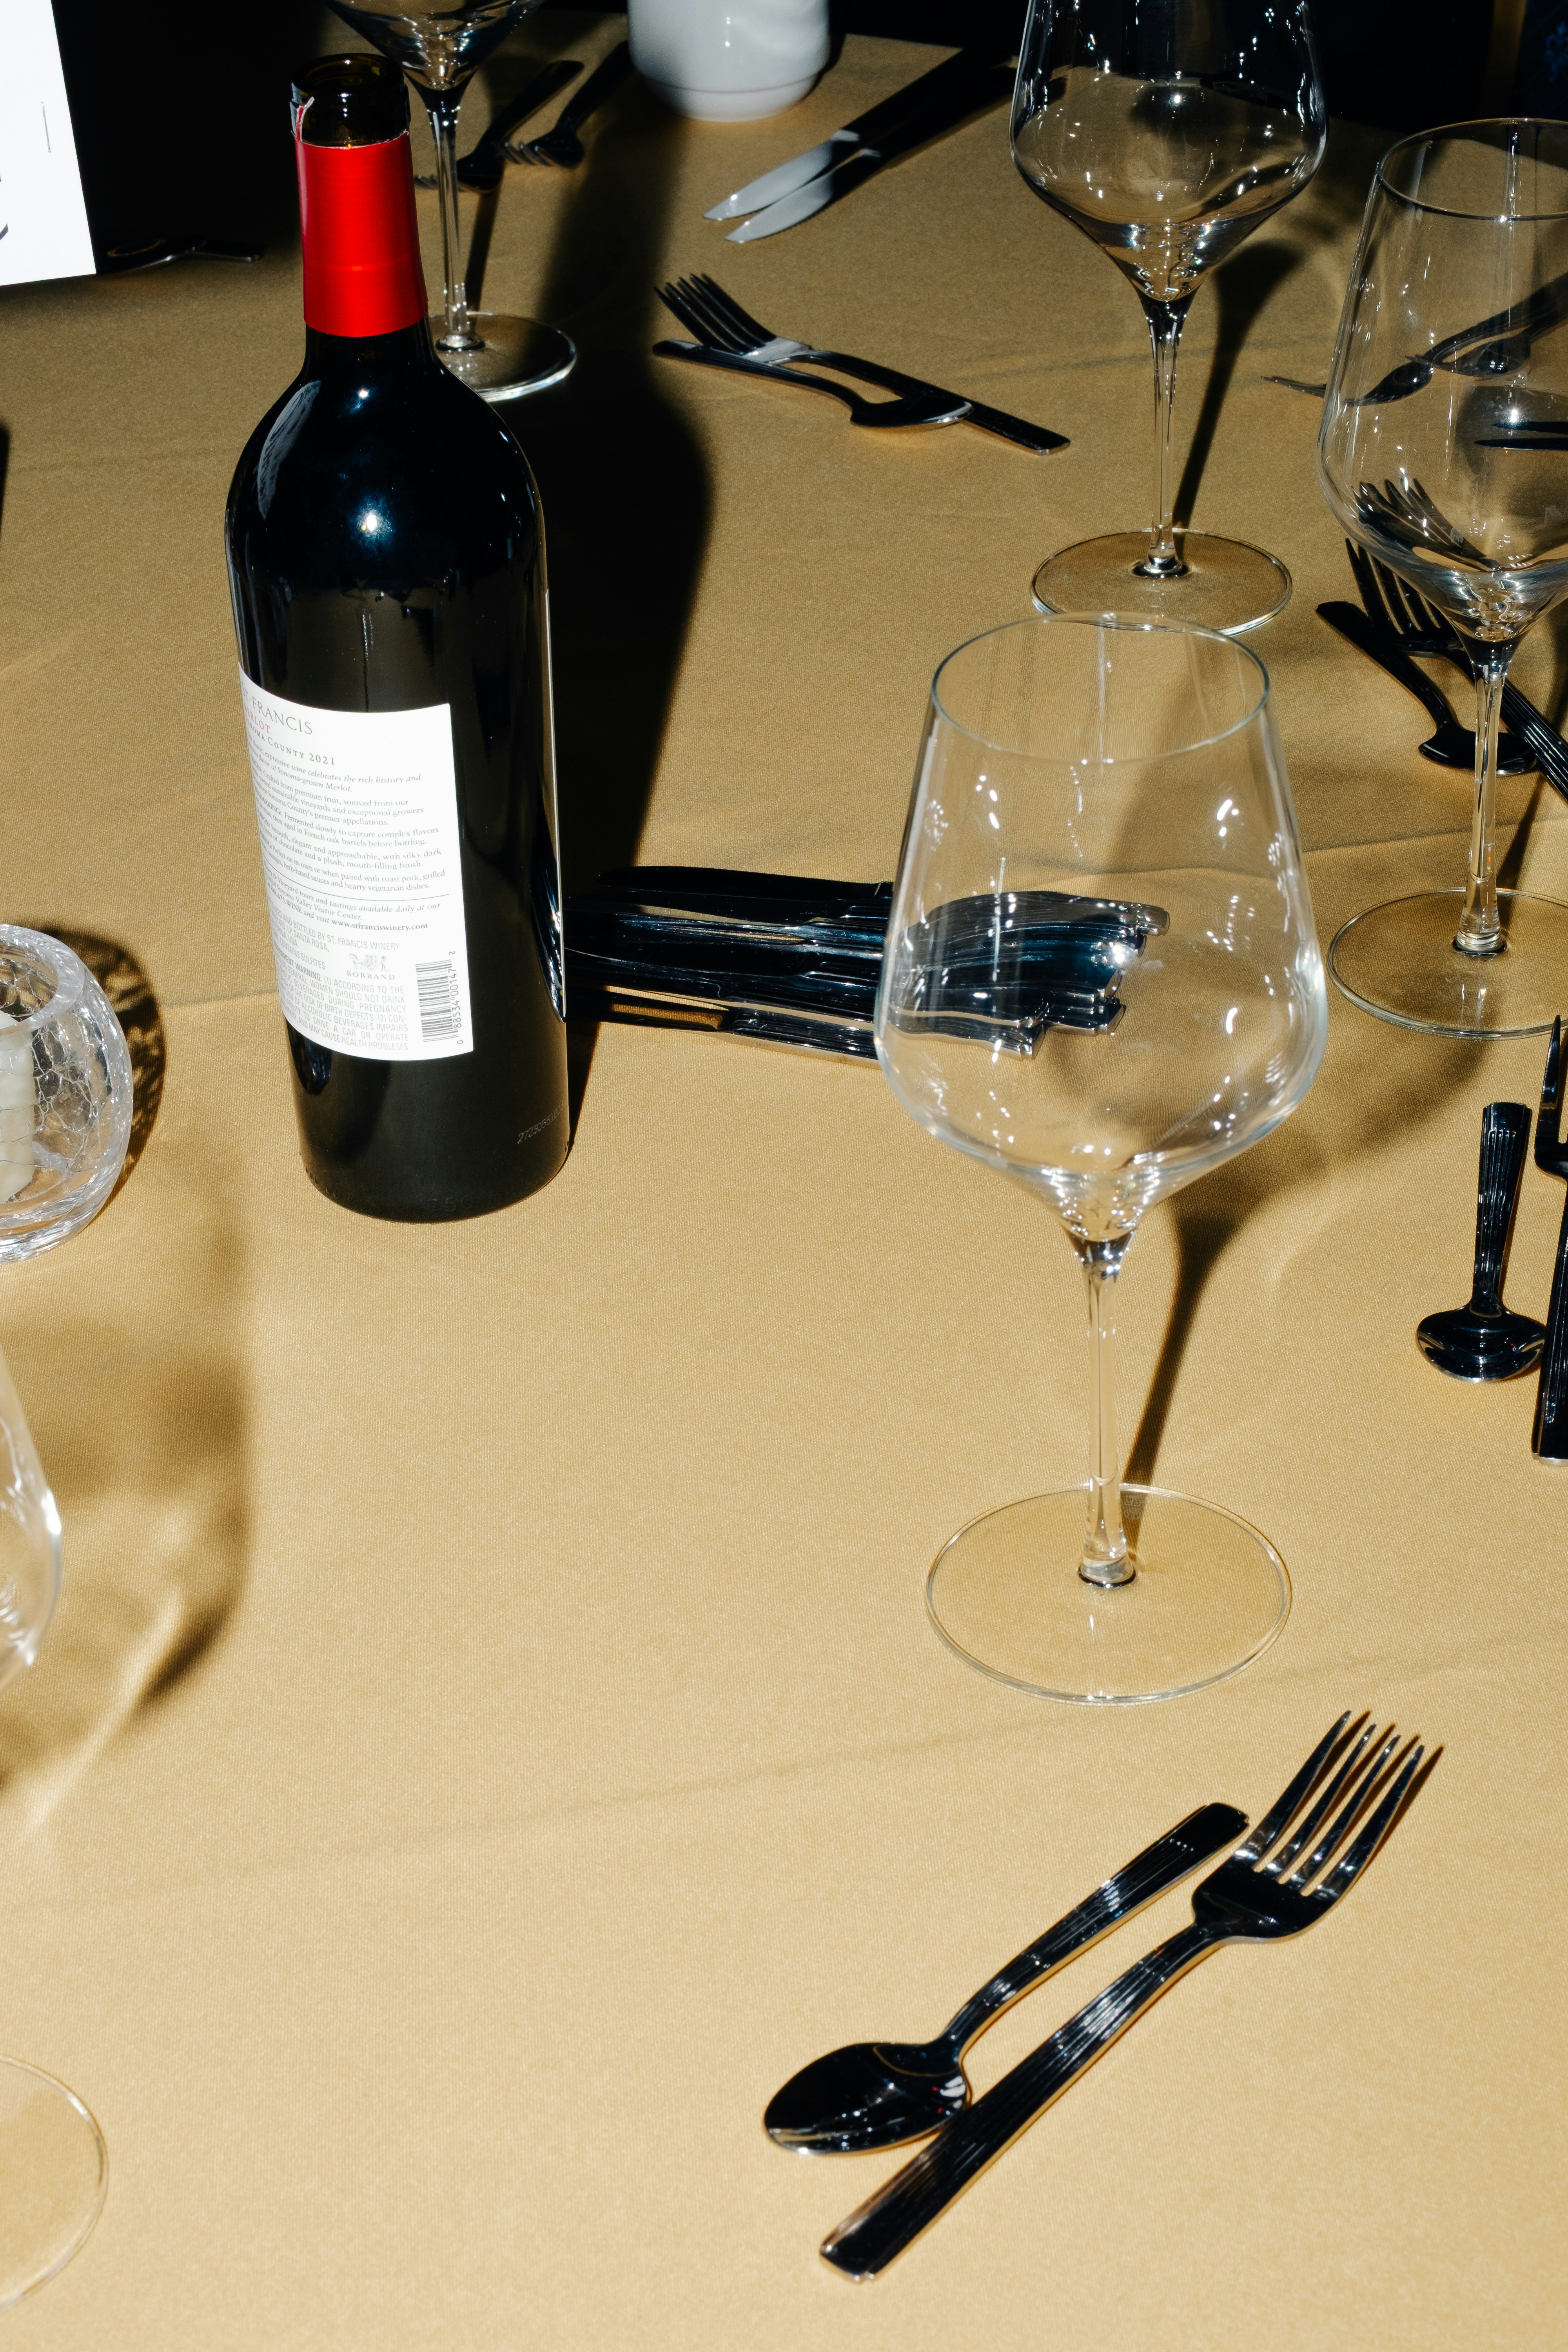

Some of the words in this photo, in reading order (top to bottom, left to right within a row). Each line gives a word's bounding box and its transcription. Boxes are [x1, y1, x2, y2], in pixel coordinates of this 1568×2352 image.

[252, 696, 312, 735] FRANCIS
[265, 752, 290, 768] expressive
[291, 765, 306, 774] wine
[308, 770, 341, 781] celebrates
[406, 773, 421, 782] and
[309, 753, 335, 766] 2021
[263, 770, 279, 786] Crafted
[280, 780, 293, 792] from
[294, 788, 322, 801] premium
[324, 795, 342, 806] fruit,
[277, 766, 323, 788] Sonoma-grown
[325, 782, 353, 792] Merlot.
[268, 790, 286, 807] Sonoma
[314, 813, 341, 823] premier
[342, 817, 389, 826] appellations.
[271, 786, 299, 803] sustainable
[300, 799, 331, 812] vineyards
[347, 809, 391, 817] exceptional
[392, 808, 424, 817] growers
[272, 814, 283, 825] then
[283, 822, 296, 831] aged
[297, 826, 303, 834] in
[304, 828, 325, 841] French
[341, 837, 367, 846] barrels
[394, 838, 427, 847] bottling.
[284, 811, 314, 829] Fermented
[315, 823, 337, 836] slowly
[377, 830, 410, 839] complex
[413, 828, 439, 836] flavors
[278, 838, 303, 855] chocolate
[323, 856, 345, 867] plush,
[346, 861, 397, 871] mouth-filling
[399, 860, 423, 869] finish.
[291, 837, 312, 850] elegant
[327, 850, 380, 861] approachable,
[403, 851, 421, 860] silky
[423, 848, 442, 857] dark
[283, 860, 310, 879] herb-based
[311, 875, 330, 885] sauces
[344, 881, 366, 892] hearty
[406, 882, 430, 891] dishes.
[301, 863, 313, 871] own
[322, 869, 339, 878] when
[401, 873, 422, 884] pork,
[423, 869, 445, 881] grilled
[276, 884, 294, 901] Sonoma
[295, 896, 312, 910] Valley
[314, 904, 335, 915] Visitor
[337, 910, 362, 920] Center.
[278, 876, 298, 894] Vineyard
[299, 891, 314, 901] tours
[330, 901, 357, 911] tastings
[395, 905, 415, 913] daily
[283, 914, 292, 926] AND
[293, 920, 316, 938] BOTTLED
[318, 931, 325, 941] BY
[338, 937, 368, 949] FRANCIS
[370, 942, 399, 950] WINERY
[331, 919, 428, 932] www.stfranciswinery.com
[288, 935, 298, 947] USA
[293, 929, 311, 945] SANTA
[311, 938, 329, 953] ROSA,
[301, 953, 325, 970] SULFITES
[347, 970, 395, 980] KOBRAND
[295, 962, 322, 982] WARNING:
[334, 979, 374, 993] ACCORDING
[377, 985, 387, 994] TO
[389, 986, 405, 994] THE
[310, 978, 333, 995] WOMEN
[335, 988, 362, 1001] SHOULD
[364, 994, 379, 1002] NOT
[382, 995, 405, 1004] DRINK
[448, 968, 459, 996] 00147
[294, 979, 324, 1001] BEVERAGES
[328, 995, 354, 1009] DURING
[359, 1002, 406, 1013] PREGNANCY
[294, 987, 303, 999] THE
[303, 994, 316, 1006] RISK
[324, 1003, 343, 1016] BIRTH
[302, 1002, 332, 1022] ALCOHOLIC
[334, 1015, 374, 1031] BEVERAGES
[376, 1023, 408, 1032] IMPAIRS
[303, 1011, 310, 1021] TO
[313, 1016, 330, 1030] DRIVE
[334, 1025, 338, 1033] A
[342, 1027, 356, 1037] CAR
[361, 1031, 370, 1039] OR
[376, 1033, 409, 1041] OPERATE
[451, 1000, 462, 1028] 88534
[298, 1016, 308, 1028] AND
[309, 1023, 320, 1035] MAY
[321, 1029, 341, 1043] CAUSE
[341, 1036, 367, 1048] HEALTH
